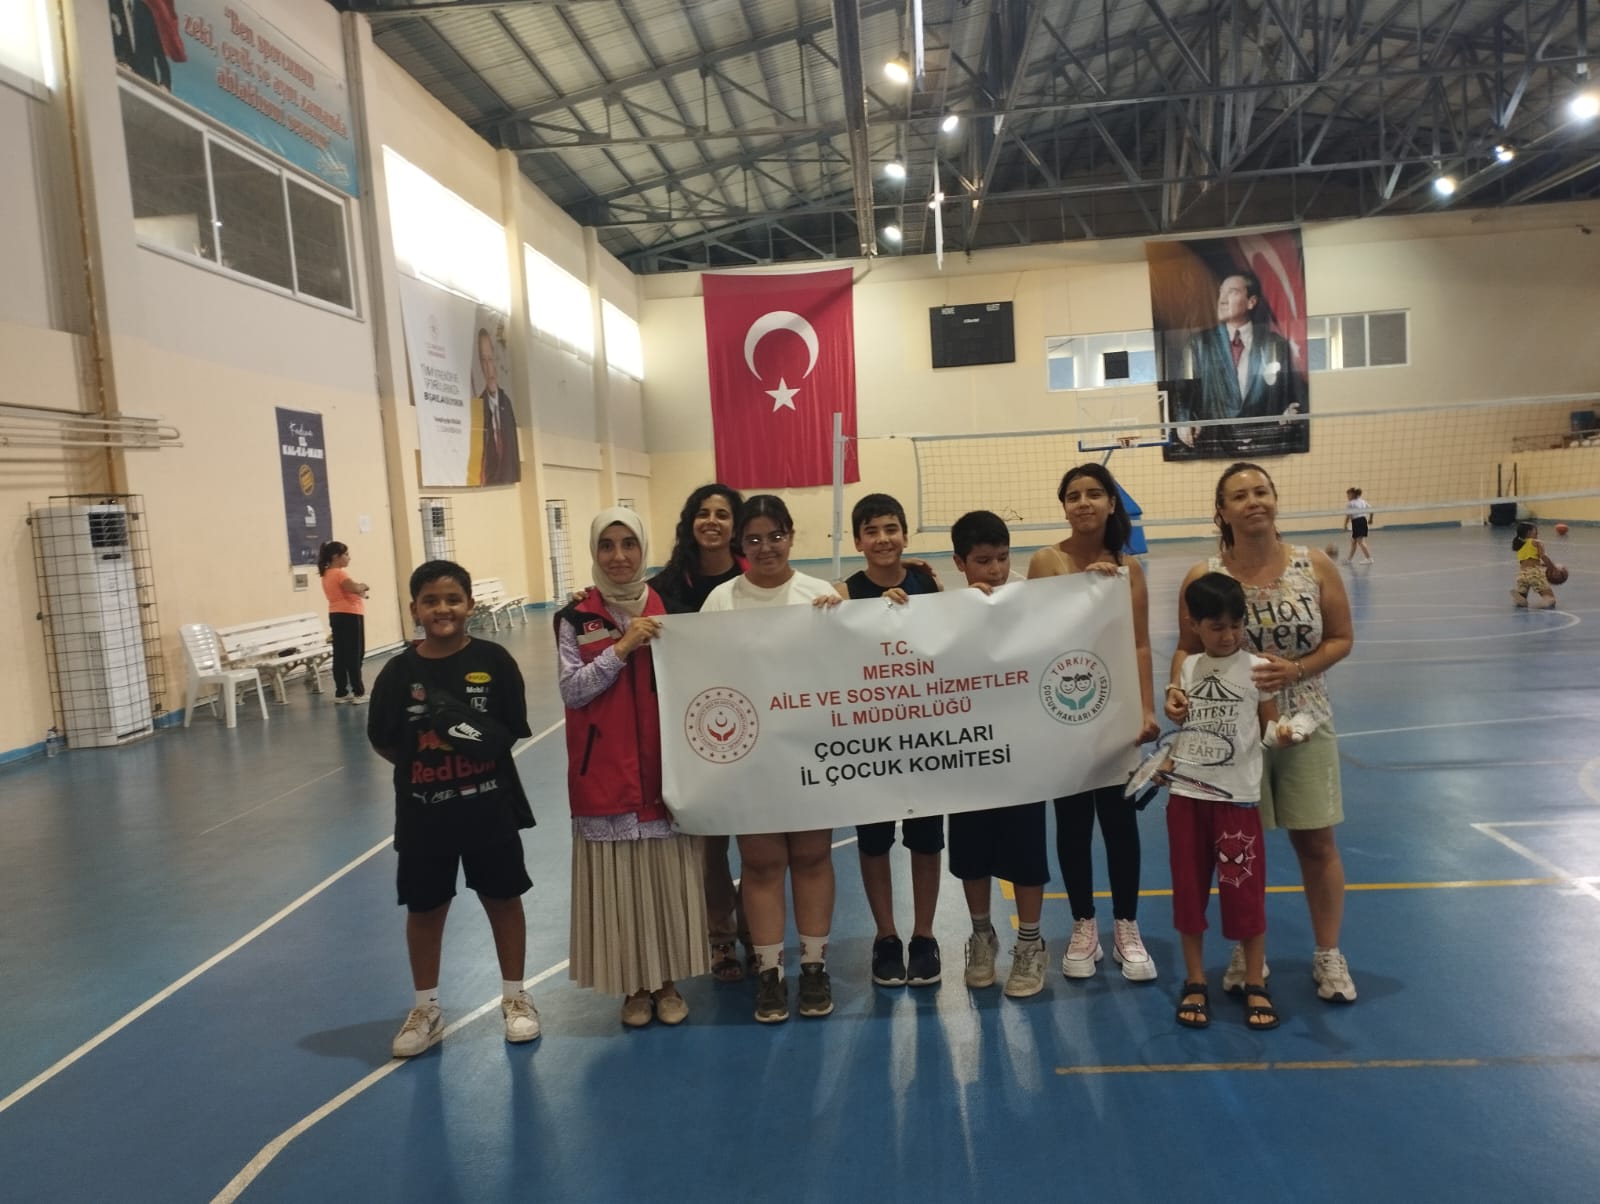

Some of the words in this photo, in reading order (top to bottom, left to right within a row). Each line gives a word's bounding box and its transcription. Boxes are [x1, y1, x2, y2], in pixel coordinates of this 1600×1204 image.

[880, 640, 914, 656] T.C.
[863, 660, 935, 680] MERSİN
[1051, 655, 1098, 676] TÜRKİYE
[769, 692, 811, 710] AİLE
[816, 691, 842, 706] VE
[847, 684, 921, 704] SOSYAL
[926, 670, 1029, 695] HİZMETLER
[1042, 684, 1058, 713] ÇOCUK
[1056, 709, 1092, 722] HAKLARI
[1091, 675, 1108, 714] KOMİTESİ
[831, 710, 848, 727] İL
[853, 696, 972, 725] MÜDÜRLÜĞÜ
[459, 722, 482, 736] NIKE
[814, 736, 893, 762] ÇOCUK
[899, 724, 994, 750] HAKLARI
[410, 754, 453, 784] Red
[800, 766, 820, 786] İL
[825, 759, 903, 786] ÇOCUK
[909, 744, 1011, 773] KOMİTESİ
